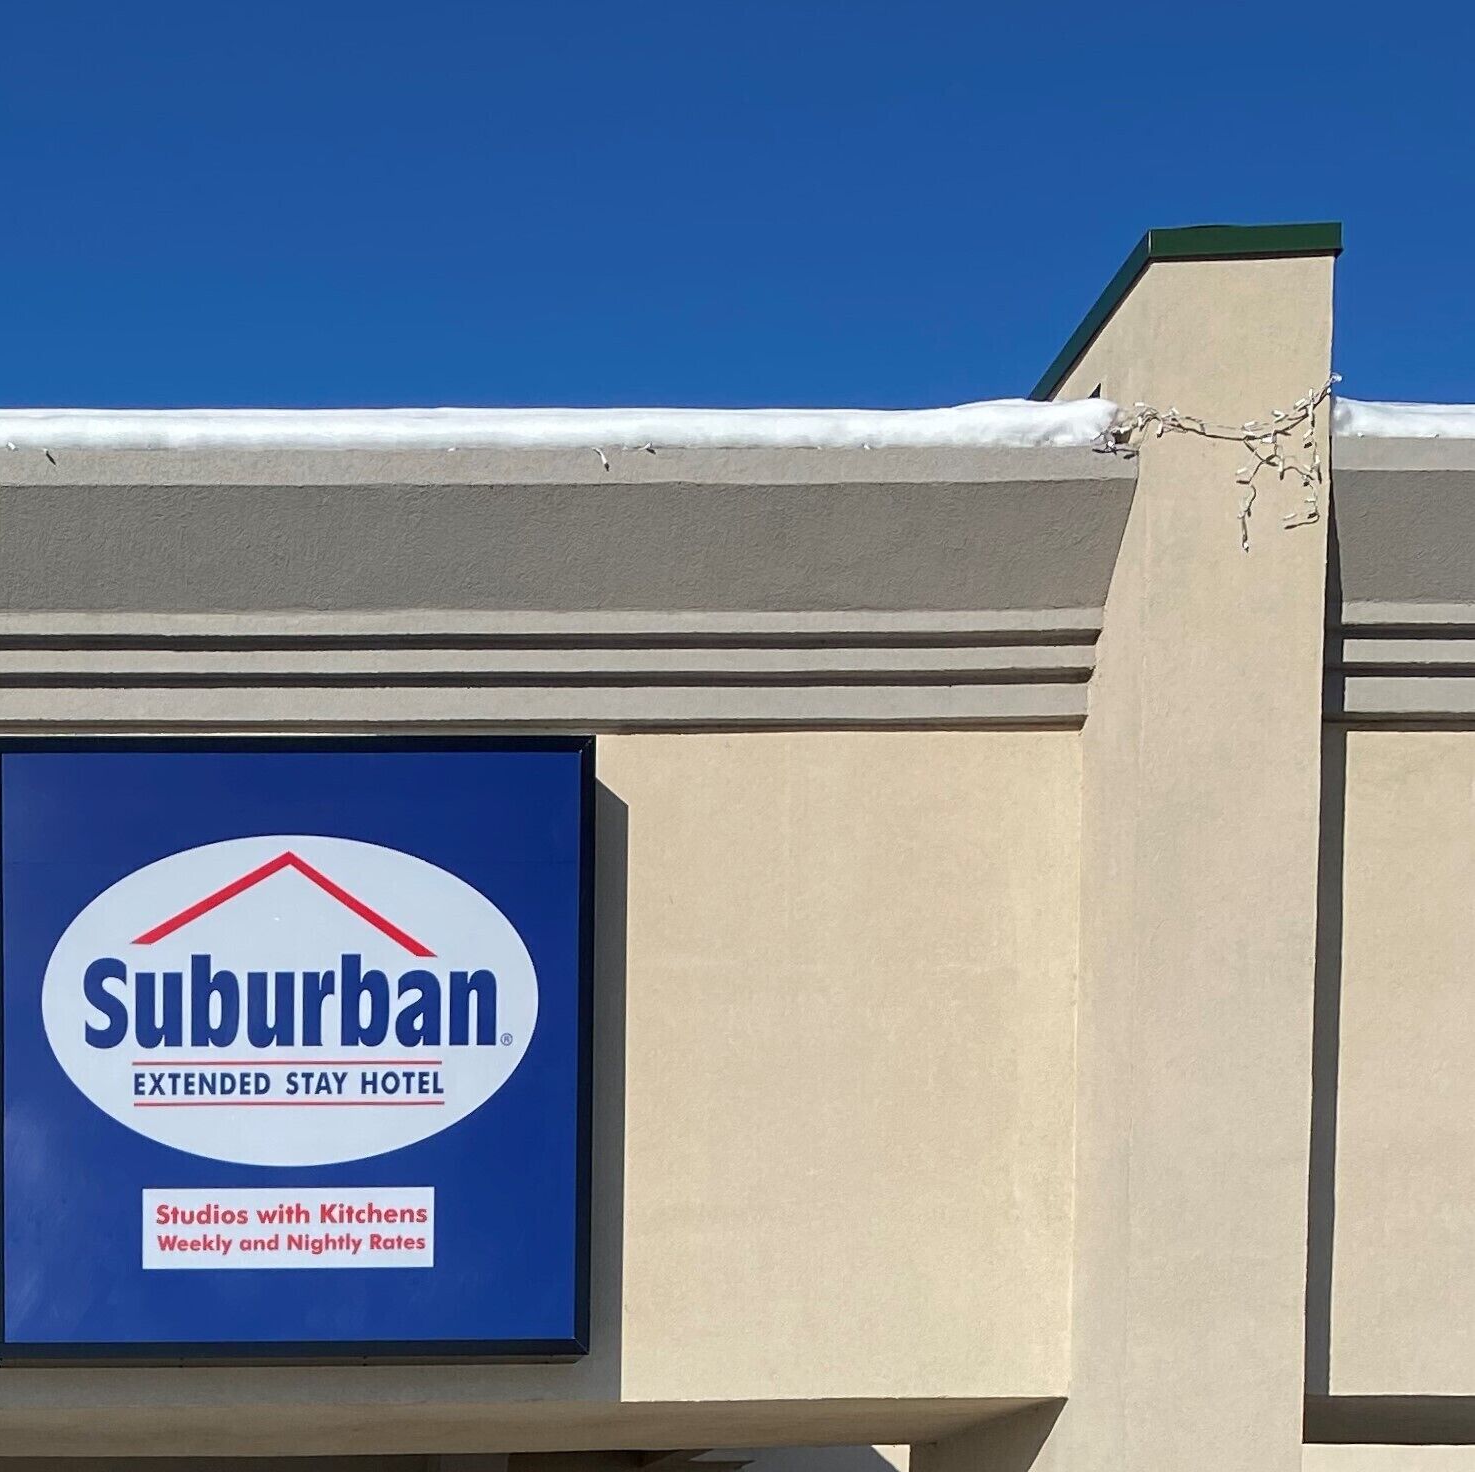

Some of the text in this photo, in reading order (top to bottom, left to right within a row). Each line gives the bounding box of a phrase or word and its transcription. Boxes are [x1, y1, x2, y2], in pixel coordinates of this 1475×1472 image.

[134, 1071, 444, 1096] EXTENDED STAY HOTEL
[156, 1202, 427, 1225] Studios with Kitchens
[157, 1233, 426, 1254] Weekly and Nightly Rates
